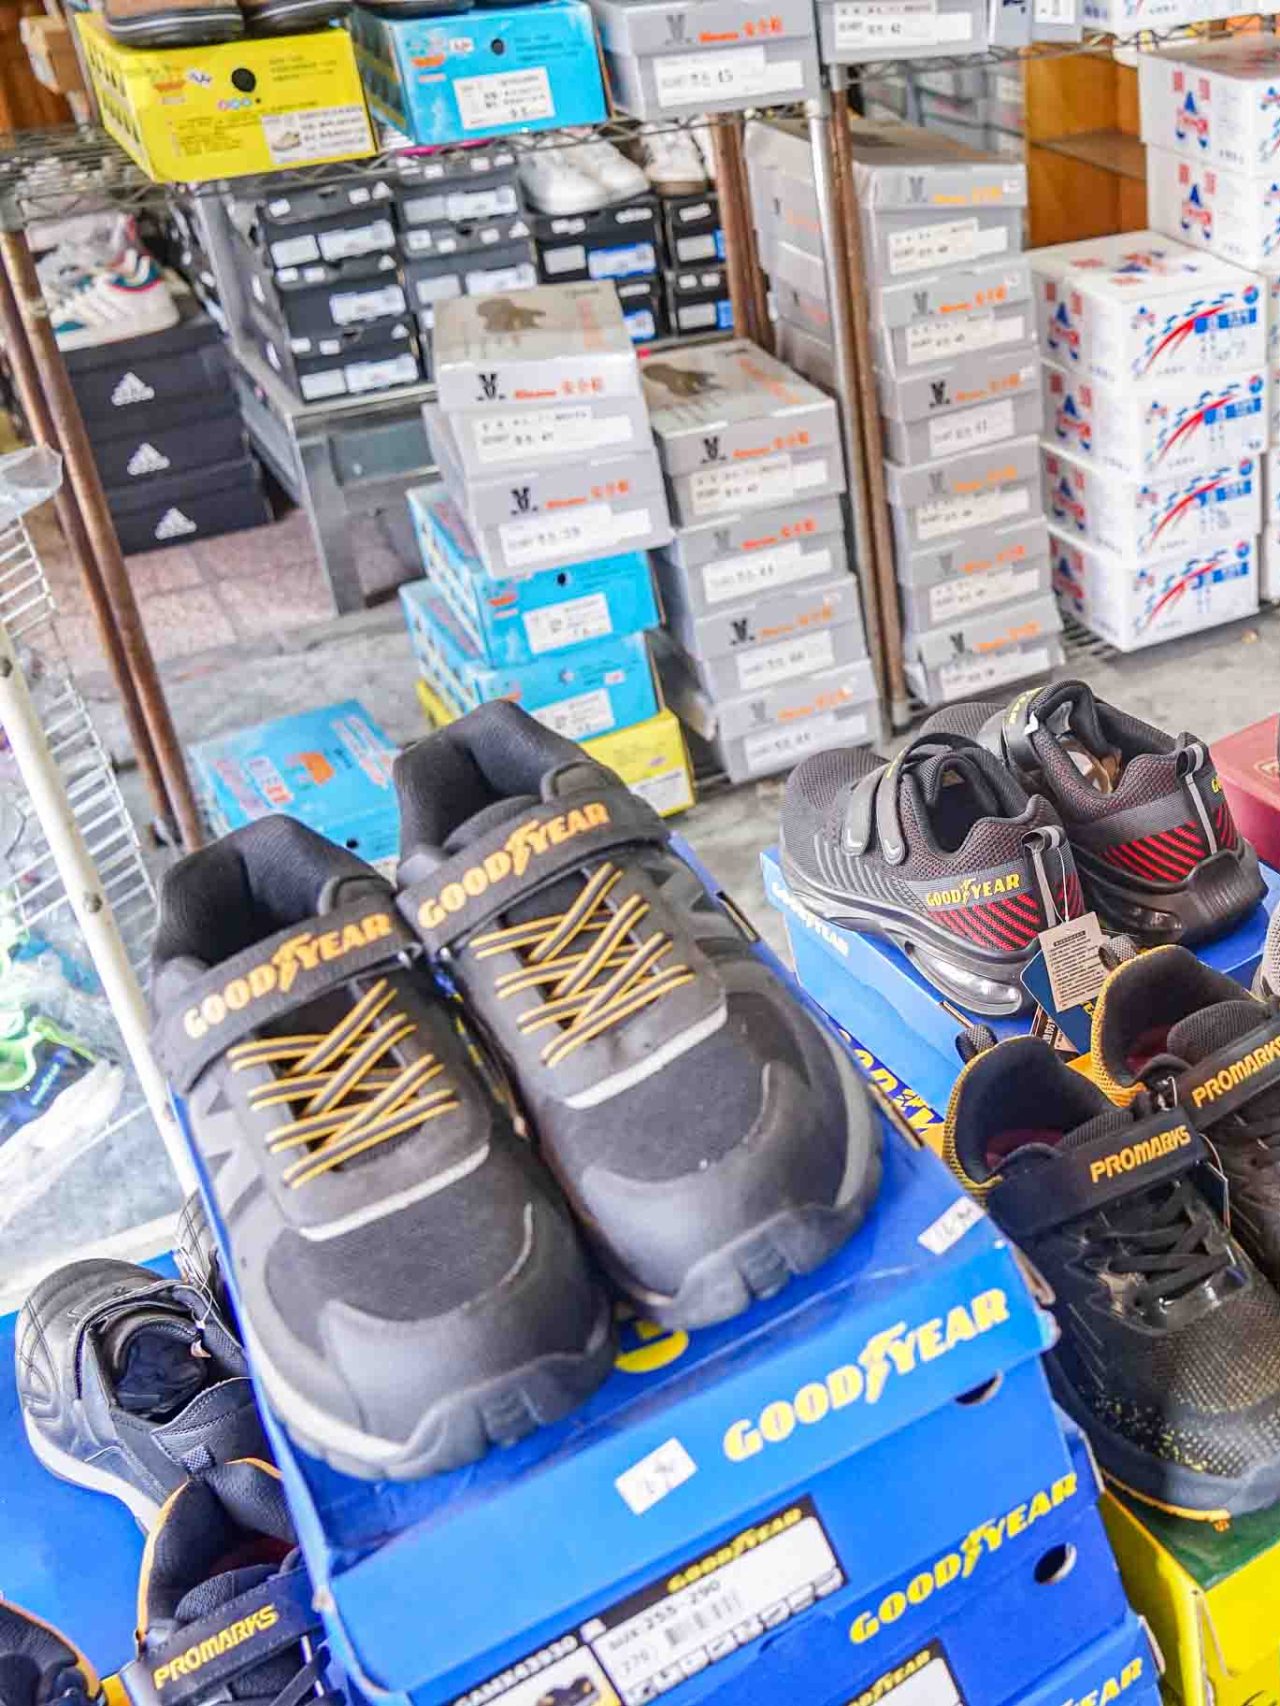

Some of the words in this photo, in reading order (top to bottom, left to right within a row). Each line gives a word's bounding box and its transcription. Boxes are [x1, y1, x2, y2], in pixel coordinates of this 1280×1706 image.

[417, 802, 611, 929] GOODYEAR
[926, 873, 1021, 908] GOODYEAR
[182, 912, 393, 1038] GOODYEAR
[1090, 1125, 1192, 1182] PROMARKS
[723, 1288, 1009, 1463] GOODYEAR
[849, 1472, 1077, 1644] GOODYEAR
[153, 1604, 280, 1689] PROMARKS
